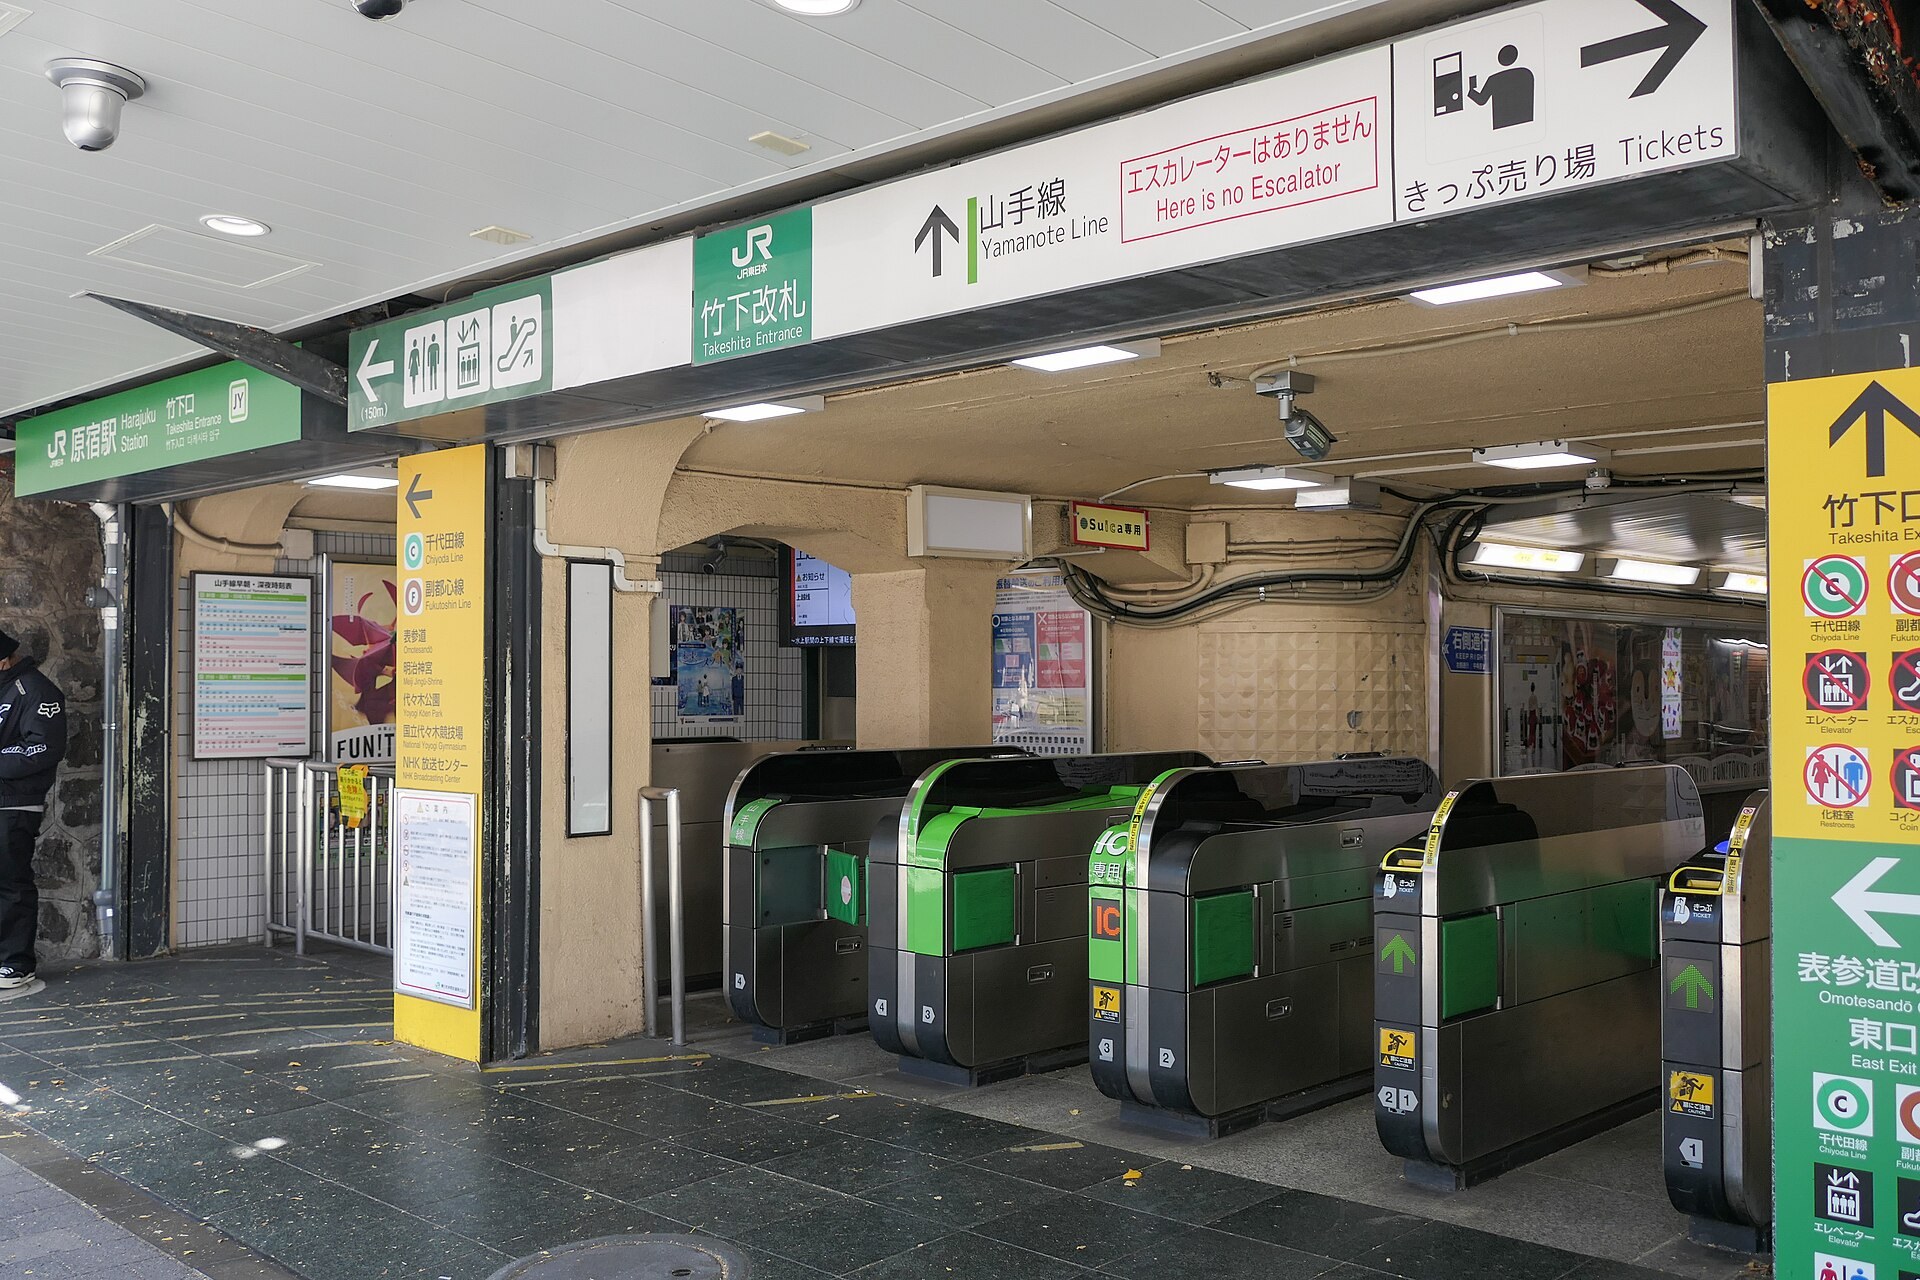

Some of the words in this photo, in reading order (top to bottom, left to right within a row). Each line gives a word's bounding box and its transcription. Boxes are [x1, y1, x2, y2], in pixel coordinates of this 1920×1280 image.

[1127, 110, 1372, 194] エスカレーターはありません
[1618, 123, 1724, 166] Tickets
[1402, 144, 1597, 213] きっぷ売り場
[1156, 194, 1195, 223] Here
[1201, 191, 1216, 212] is
[1220, 185, 1244, 207] no
[1251, 160, 1342, 202] Escalator
[980, 177, 1066, 232] 山手線
[731, 223, 773, 267] JR
[981, 223, 1066, 261] Yamanote
[1071, 214, 1109, 240] Line
[736, 262, 768, 280] JR東日本
[699, 278, 807, 339] 竹下改札
[702, 335, 752, 358] Takeshita
[755, 324, 804, 349] Entrance
[166, 393, 194, 420] 竹下口
[233, 391, 244, 410] JY
[120, 407, 156, 431] Harajuku
[360, 404, 388, 422] (150m)
[165, 419, 194, 435] Takeshita
[194, 414, 222, 429] Entrance
[47, 429, 66, 459] JR
[70, 418, 117, 464] 原宿駅
[120, 433, 149, 453] Station
[1089, 518, 1141, 536] Suica専用
[425, 531, 465, 552] 千代田線
[1828, 529, 1899, 545] Takeshita
[410, 545, 416, 557] C
[425, 553, 450, 567] Chiyoda
[450, 552, 464, 563] Line
[214, 579, 293, 590] 山手線早朝・深夜時刻表
[802, 572, 825, 581] お知らせ
[425, 578, 465, 598] 副都心線
[1825, 577, 1840, 596] C
[411, 591, 416, 602] F
[425, 600, 458, 611] Fukutoshin
[458, 598, 472, 609] Line
[1810, 620, 1861, 633] 千代田線
[403, 629, 427, 643] 表参道
[1452, 630, 1490, 651] 右側通行
[1810, 633, 1842, 643] Chiyoda
[1843, 633, 1860, 641] Line
[1455, 652, 1469, 660] KEEP
[403, 661, 433, 675] 明治神宮
[403, 692, 440, 707] 代々木公園
[403, 709, 421, 718] Yoyogi
[431, 709, 443, 718] Park
[1805, 715, 1869, 725] エレベーター
[1887, 715, 1919, 725] エスカ
[403, 724, 463, 740] 国立代々木競技場
[1820, 726, 1853, 734] Elevator
[402, 756, 420, 769] NHK
[421, 757, 469, 772] 放送センター
[402, 771, 413, 780] NHK
[1821, 809, 1855, 822] 化粧室
[1889, 811, 1920, 823] コイン
[1819, 821, 1856, 830] Restrooms
[1899, 823, 1919, 832] Coin
[1095, 830, 1128, 856] IC
[1093, 861, 1121, 879] 専用
[1399, 879, 1416, 888] きっぷ
[1693, 903, 1713, 913] きっぷ
[1096, 905, 1120, 936] IC
[736, 976, 742, 986] 4
[878, 1002, 885, 1012] 4
[1819, 989, 1913, 1013] Omotesandō
[924, 1009, 931, 1020] 3
[1849, 1017, 1917, 1055] 東口
[1103, 1042, 1111, 1053] 3
[1162, 1052, 1169, 1063] 2
[1851, 1054, 1885, 1072] East
[1889, 1057, 1917, 1076] Exit
[1385, 1091, 1393, 1103] 2
[1403, 1094, 1409, 1106] 1
[1834, 1094, 1848, 1113] C
[1687, 1108, 1707, 1116] CAUTION
[1689, 1143, 1696, 1157] 1
[1818, 1132, 1868, 1152] 千代田線
[1818, 1145, 1850, 1158] Chiyoda
[1850, 1150, 1867, 1160] Line
[1813, 1222, 1875, 1240] エレベーター
[1828, 1235, 1859, 1248] Elevator
